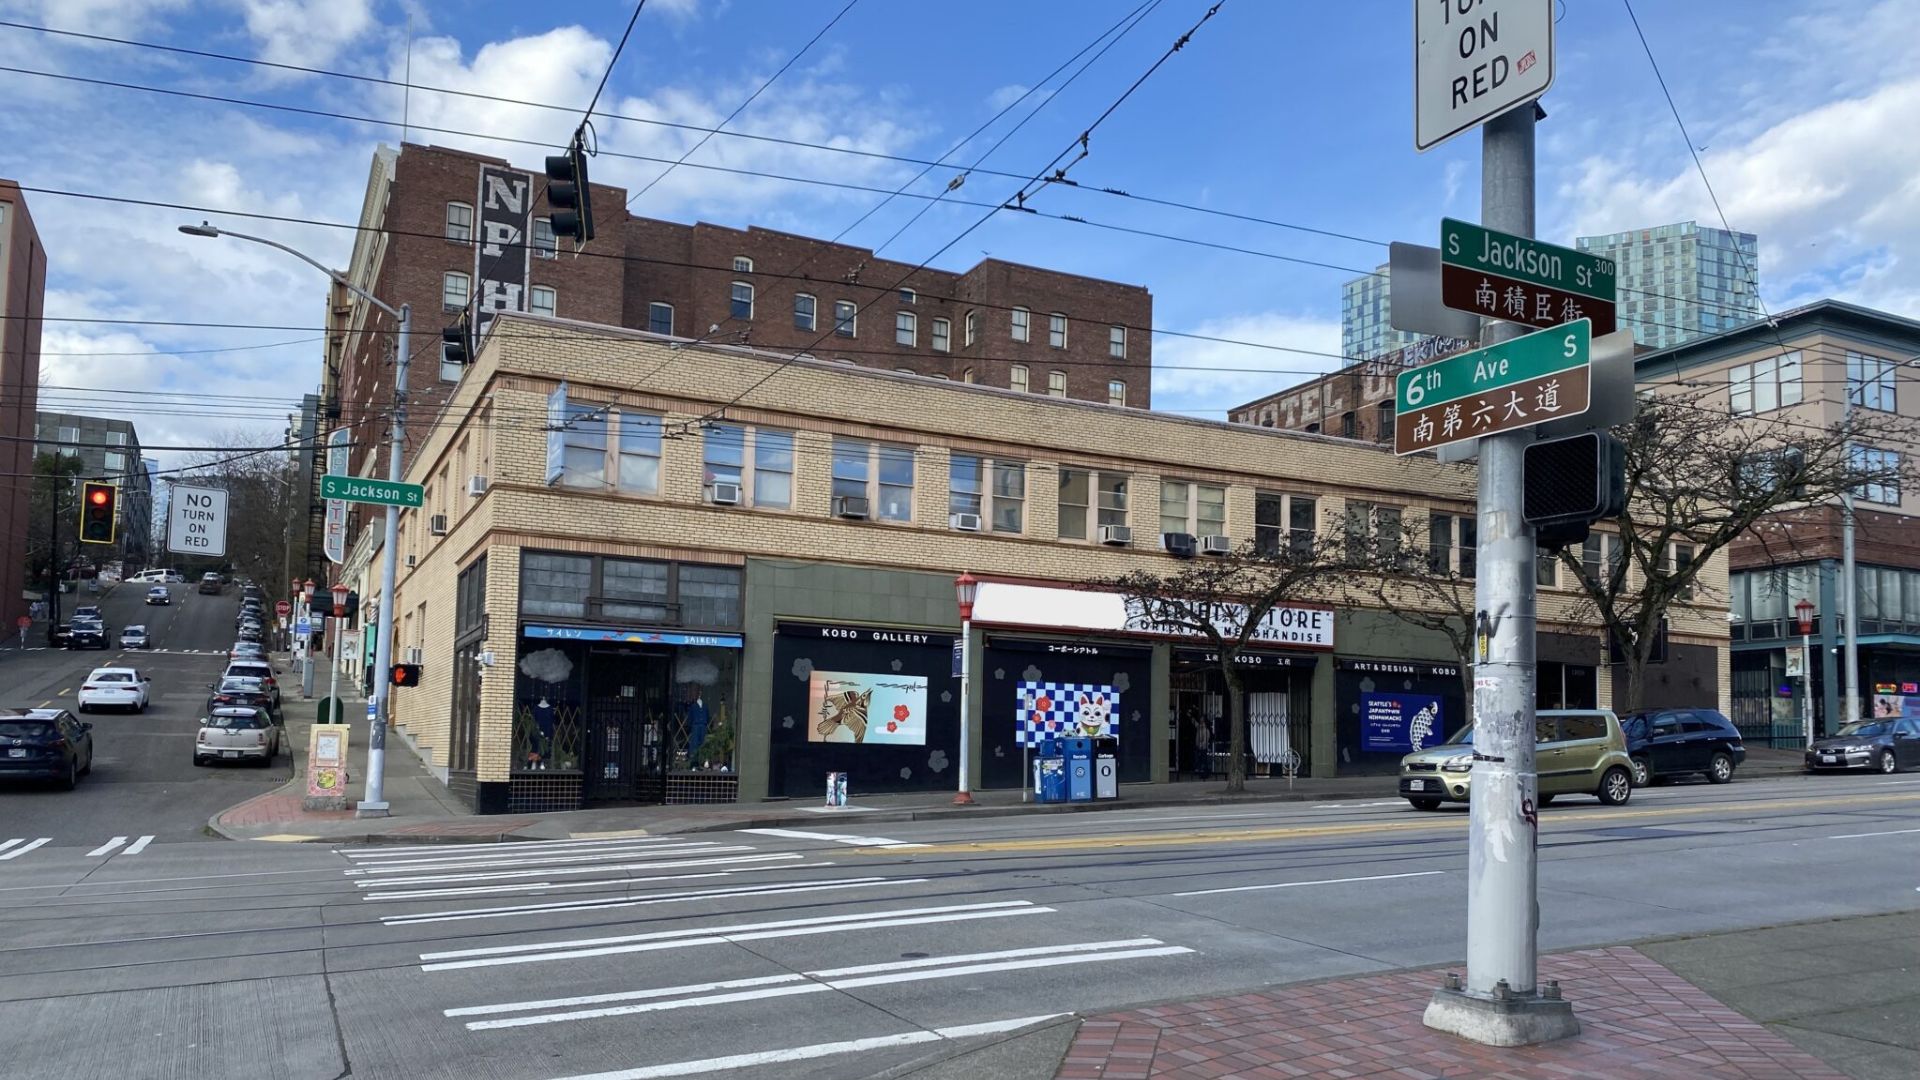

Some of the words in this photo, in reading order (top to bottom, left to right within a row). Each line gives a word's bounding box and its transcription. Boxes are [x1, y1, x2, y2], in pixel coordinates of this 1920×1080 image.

[1460, 11, 1498, 59] ON
[1452, 55, 1509, 110] RED
[1448, 233, 1460, 256] S
[1477, 232, 1562, 281] Jackson
[1576, 265, 1592, 288] St
[1595, 259, 1614, 276] 300
[1475, 278, 1583, 323] 南積臣街
[1406, 368, 1441, 405] 6th
[1473, 358, 1509, 383] Ave
[1563, 334, 1577, 357] S
[1413, 379, 1562, 443] 南第六大道
[327, 481, 335, 493] S
[342, 482, 400, 500] Jackson
[407, 492, 417, 502] St
[187, 494, 212, 508] NO
[182, 509, 214, 522] TURN
[189, 523, 206, 534] ON
[185, 536, 209, 547] RED
[1266, 609, 1322, 629] TORE
[822, 628, 858, 639] KOBO
[872, 631, 928, 643] GALLERY
[1224, 626, 1322, 642] MECHANDISE
[1234, 656, 1262, 664] KOBO
[1354, 663, 1371, 671] ART
[1381, 664, 1414, 673] DESIGN
[1432, 667, 1456, 675] KOBO
